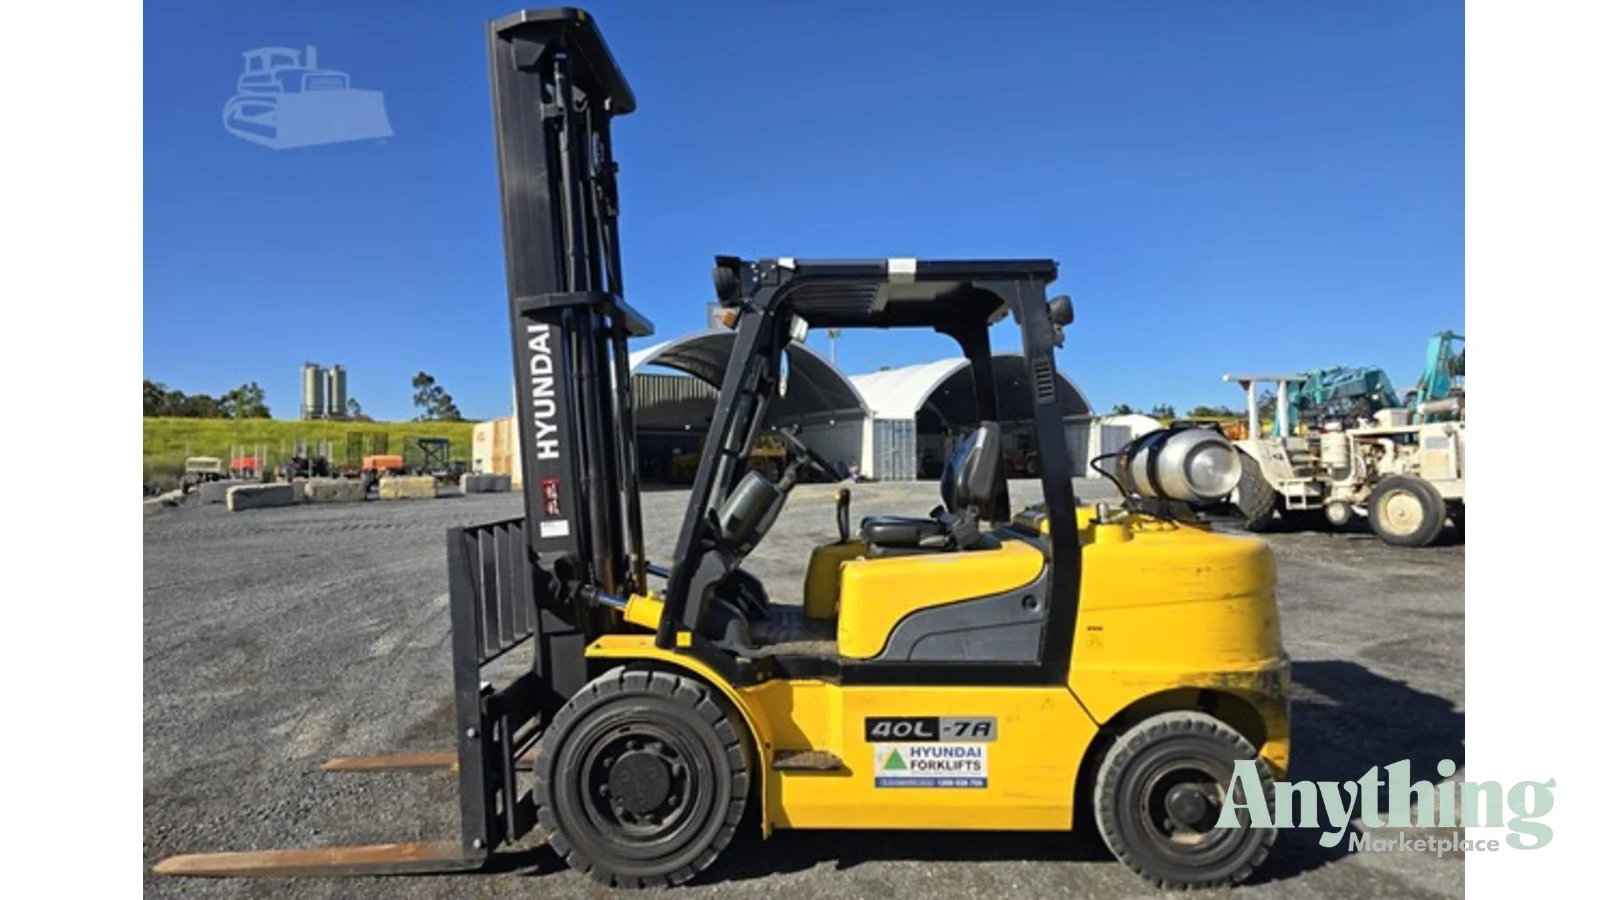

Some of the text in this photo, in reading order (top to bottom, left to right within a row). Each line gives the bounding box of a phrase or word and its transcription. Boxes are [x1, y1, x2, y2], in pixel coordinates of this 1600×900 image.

[527, 323, 559, 460] HYUNDAI
[910, 746, 982, 758] HYUNDAI
[910, 759, 982, 771] FORKLIFTS
